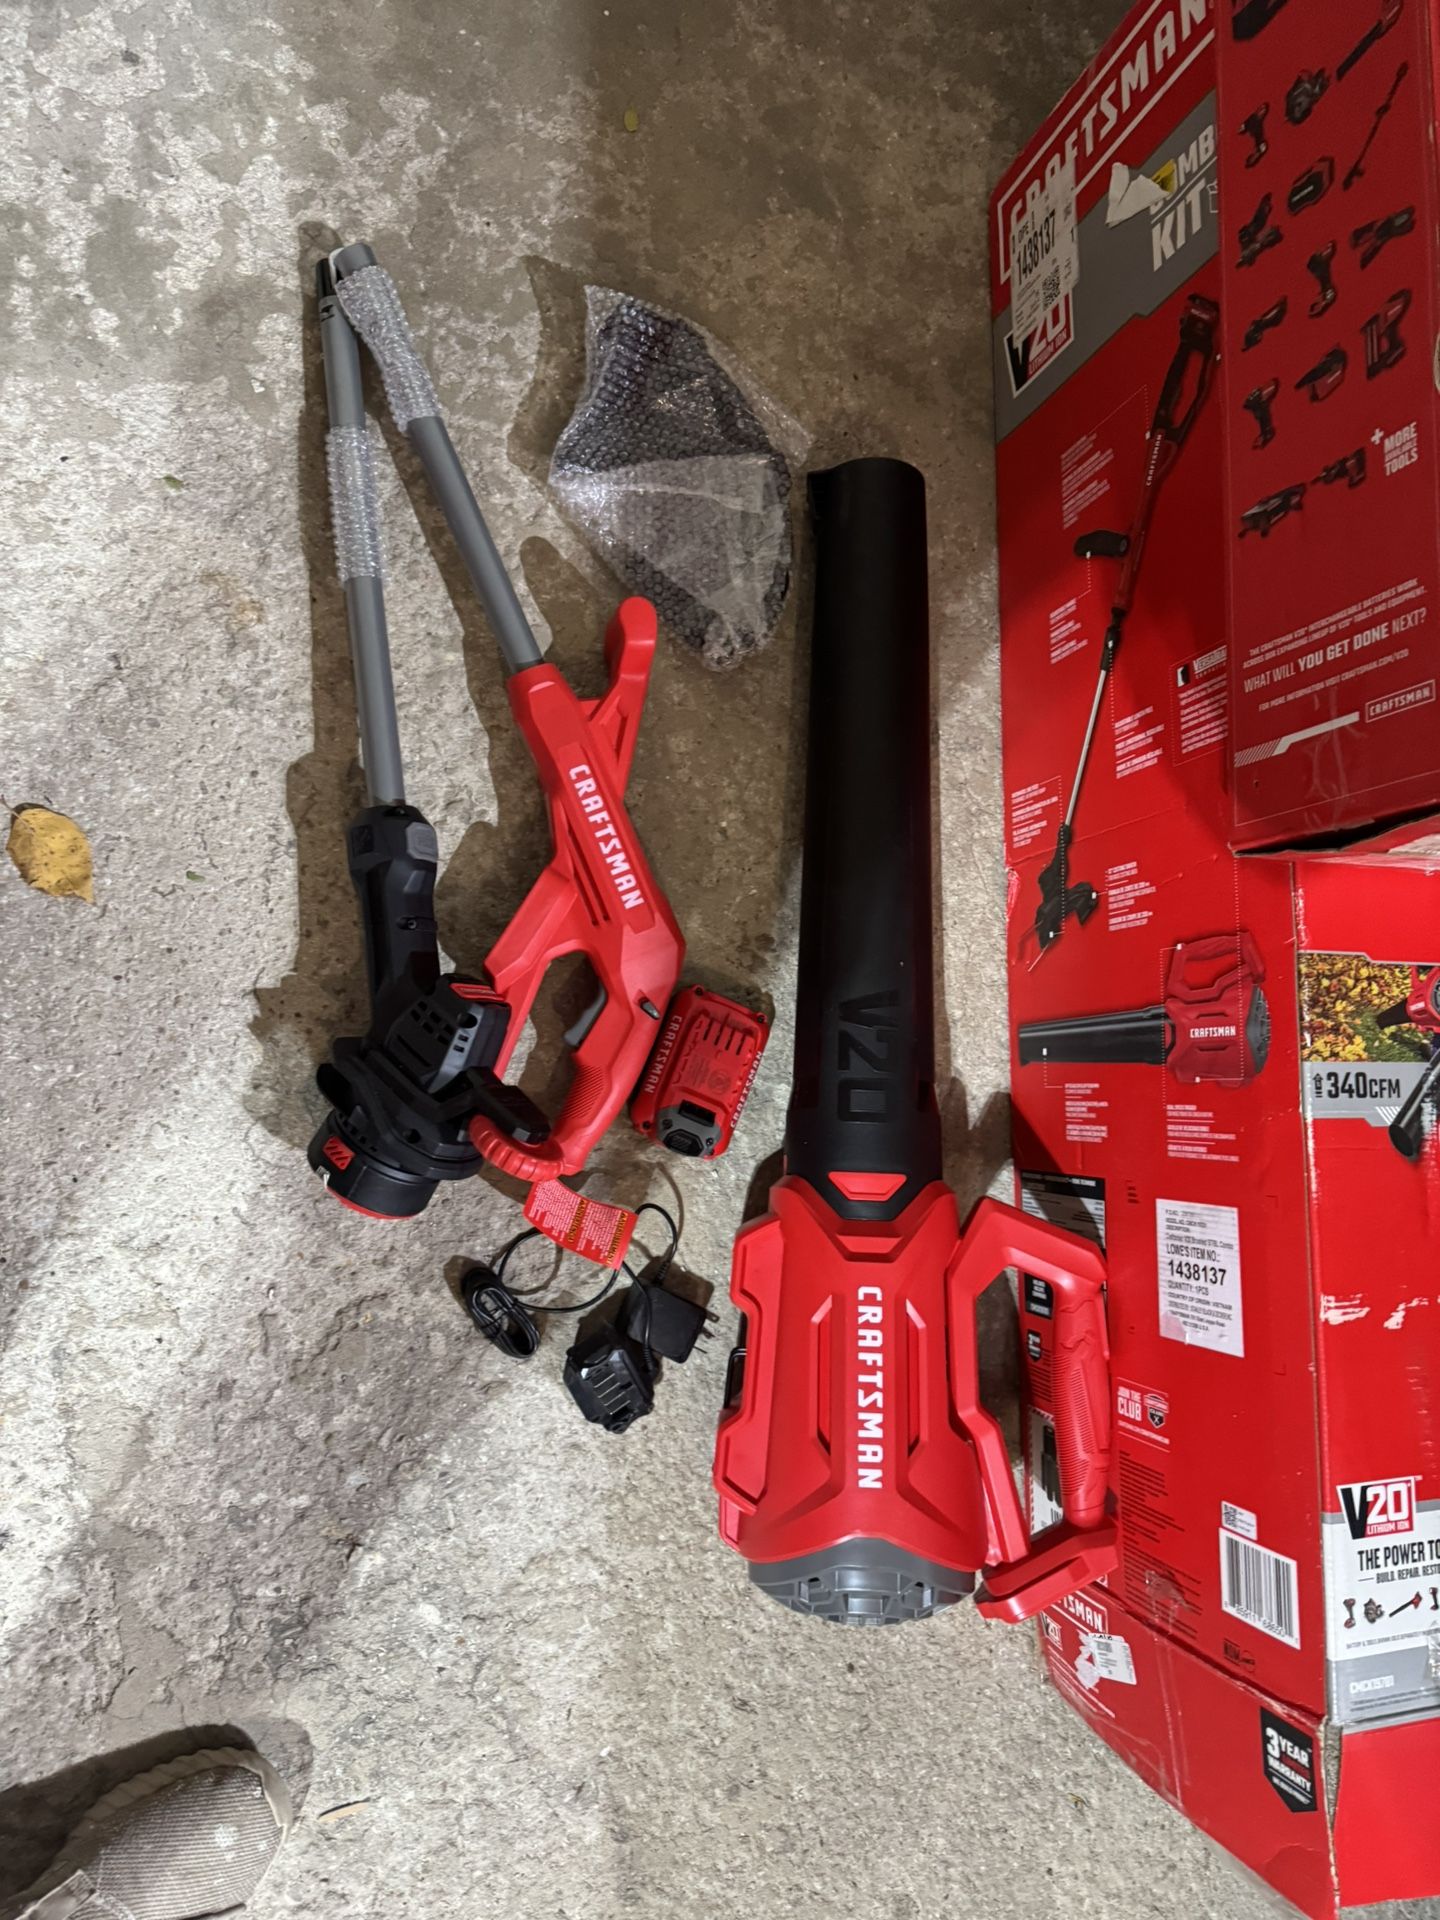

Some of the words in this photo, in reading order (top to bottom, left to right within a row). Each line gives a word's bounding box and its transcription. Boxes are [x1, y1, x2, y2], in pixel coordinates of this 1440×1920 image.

[1151, 177, 1206, 272] KIT
[1016, 208, 1056, 286] 1438137
[1384, 421, 1417, 454] MORE
[1145, 434, 1162, 487] CRAFTSMAN
[1384, 447, 1418, 476] TOOLS
[1362, 585, 1397, 609] BATTERIES
[1243, 670, 1271, 694] WHAT
[1272, 661, 1297, 683] WILL
[1298, 653, 1324, 673] YOU
[1326, 638, 1351, 662] GET
[1353, 621, 1390, 651] DONE
[1391, 606, 1428, 635] NEXT?
[1369, 686, 1431, 716] CRAFTSMAN
[567, 763, 646, 910] CRAFTSMAN
[1189, 1026, 1237, 1039] CRAFTSMAN
[644, 1015, 683, 1095] CRAFTSMAN
[837, 988, 899, 1123] V20
[729, 1051, 764, 1130] CRAFTSMAN
[1166, 1243, 1191, 1258] LOWE'S
[1190, 1247, 1206, 1260] ITEM
[1168, 1259, 1227, 1286] 1438137
[857, 1286, 883, 1490] CRAFTSMAN
[1117, 1396, 1142, 1421] CLUB
[1340, 1482, 1410, 1540] V20
[1367, 1523, 1396, 1535] LITHIUM
[1396, 1520, 1410, 1531] ION
[1357, 1548, 1381, 1572] THE
[1383, 1541, 1426, 1568] POWER
[1265, 1727, 1281, 1759] 3
[1279, 1735, 1311, 1768] YEAR
[1266, 1754, 1312, 1792] WARRANTY
